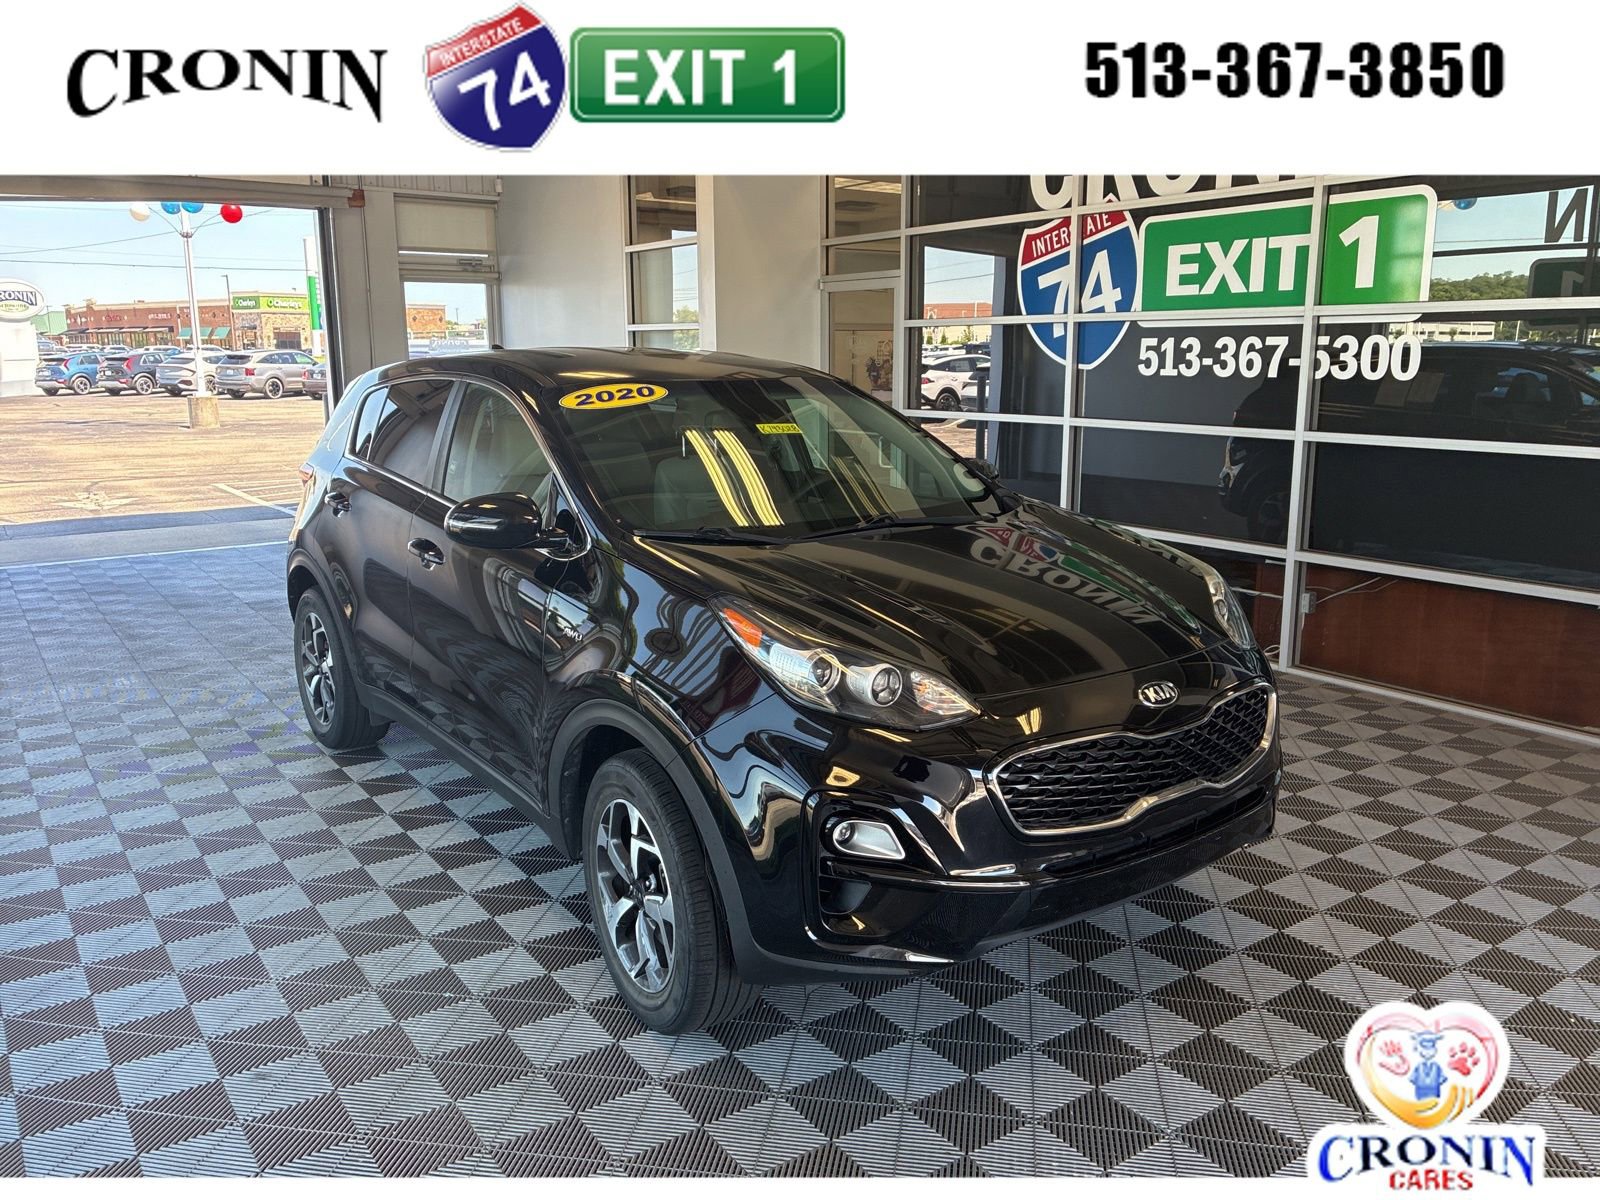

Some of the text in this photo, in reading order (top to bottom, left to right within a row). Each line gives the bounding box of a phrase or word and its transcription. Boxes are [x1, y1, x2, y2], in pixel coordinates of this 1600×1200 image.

[1031, 212, 1112, 258] INTERATE
[1166, 215, 1380, 297] EXIT 1
[1037, 249, 1122, 338] 74
[574, 386, 655, 406] 2020
[1143, 684, 1175, 703] KIA
